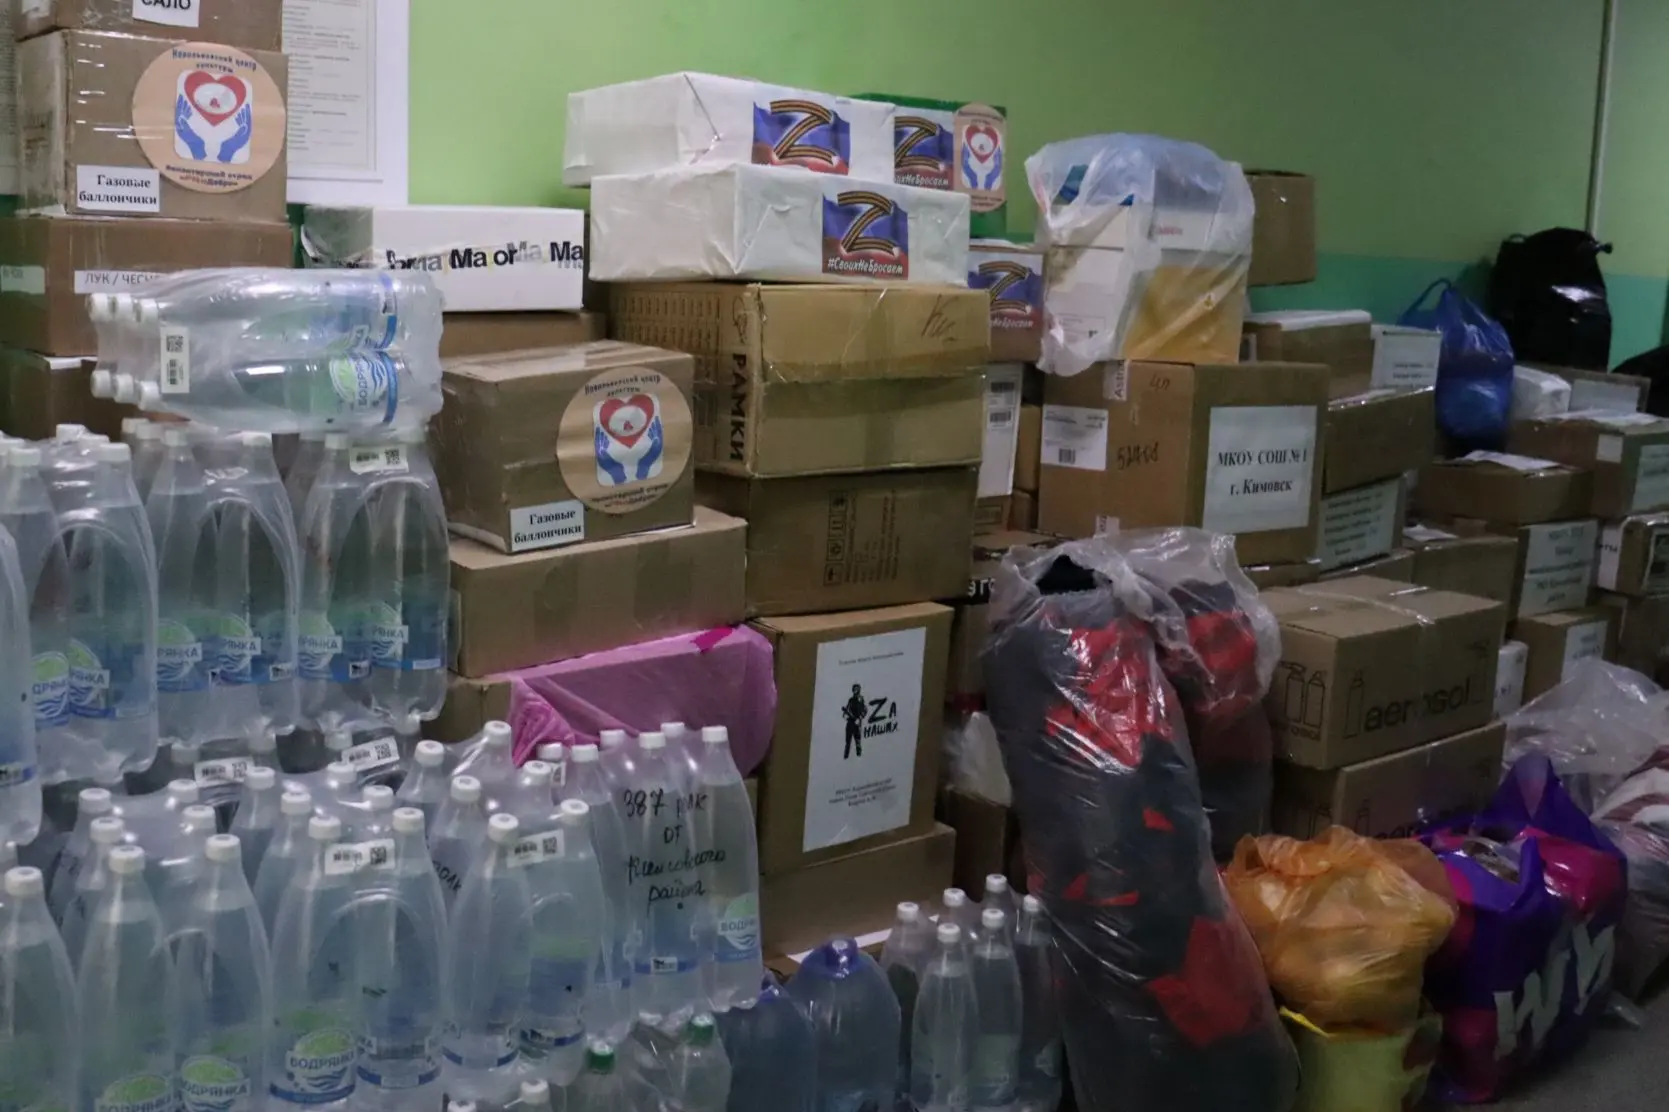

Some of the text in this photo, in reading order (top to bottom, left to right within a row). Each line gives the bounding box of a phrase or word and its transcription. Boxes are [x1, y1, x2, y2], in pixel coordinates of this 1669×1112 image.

[97, 174, 151, 189] Газовые
[79, 190, 157, 206] баллончики
[827, 256, 903, 276] #СвоихНеБросаем
[84, 272, 110, 284] ЛУК
[730, 352, 747, 461] РАМКИ
[1218, 450, 1254, 467] МКОУ
[1257, 448, 1287, 465] СОШ
[1230, 478, 1294, 496] г. Кимовск
[529, 510, 576, 526] Газовые
[514, 525, 582, 544] баллончики
[624, 788, 667, 818] 387
